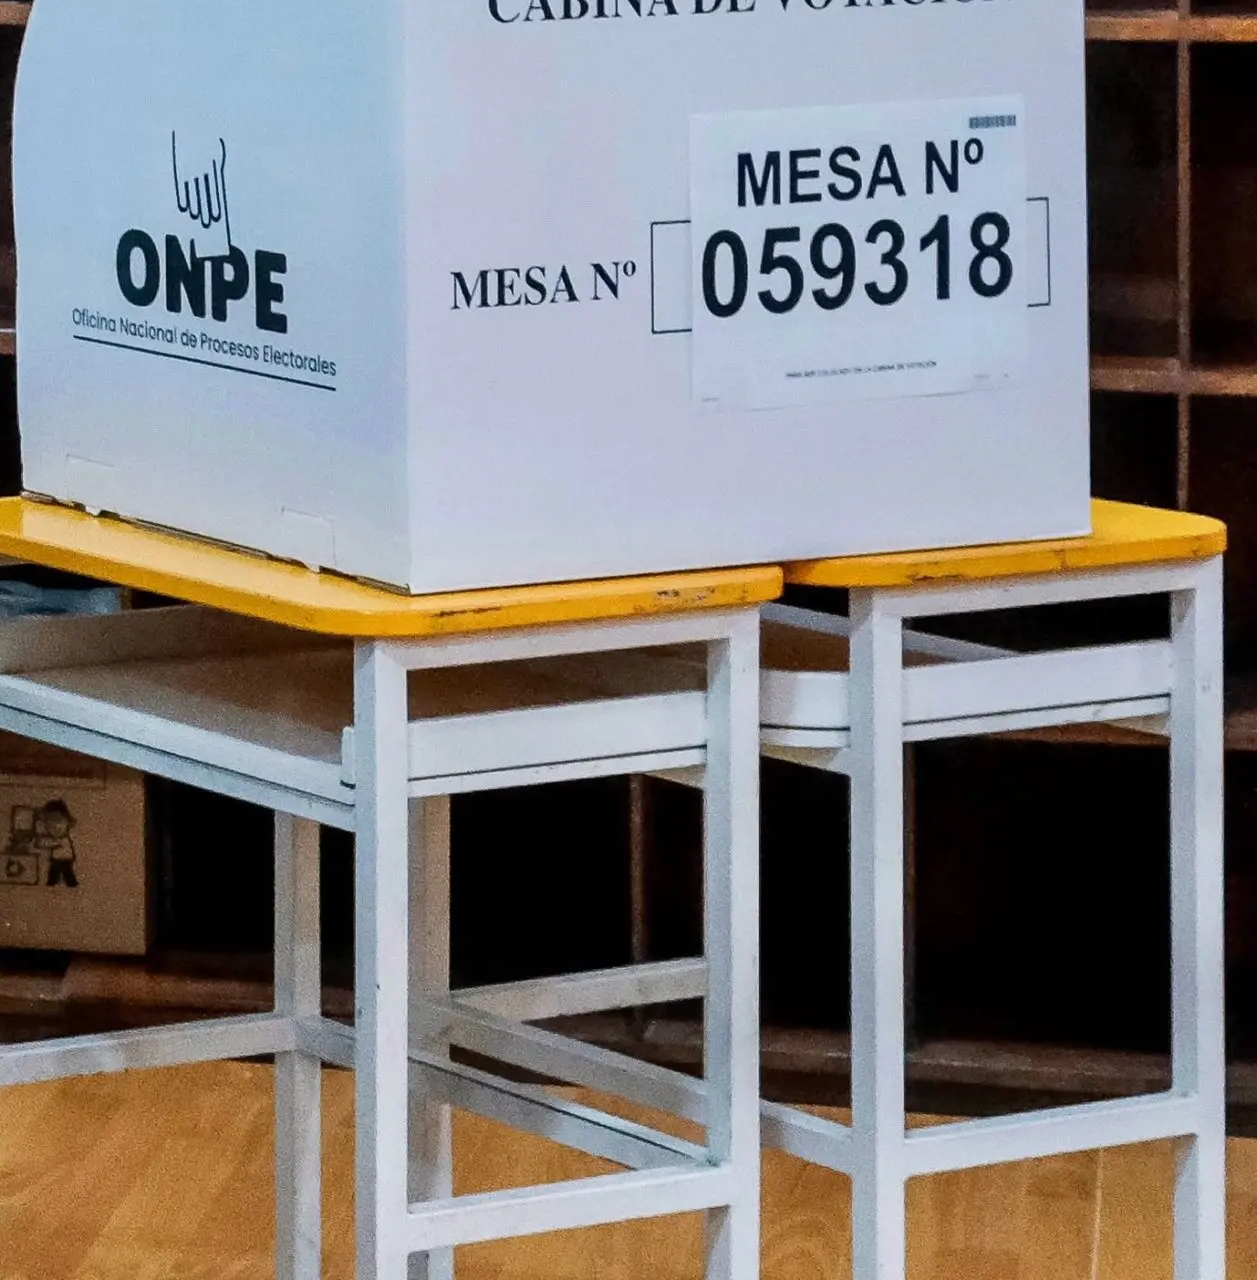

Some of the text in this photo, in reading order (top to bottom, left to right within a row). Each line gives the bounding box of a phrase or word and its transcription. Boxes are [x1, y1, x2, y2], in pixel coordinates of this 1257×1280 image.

[737, 143, 907, 208] MESA
[116, 228, 288, 334] ONPE
[450, 264, 580, 310] MESA
[701, 211, 1014, 318] 059318
[72, 308, 337, 376] Oficina Nacional de Procesos Electorales
